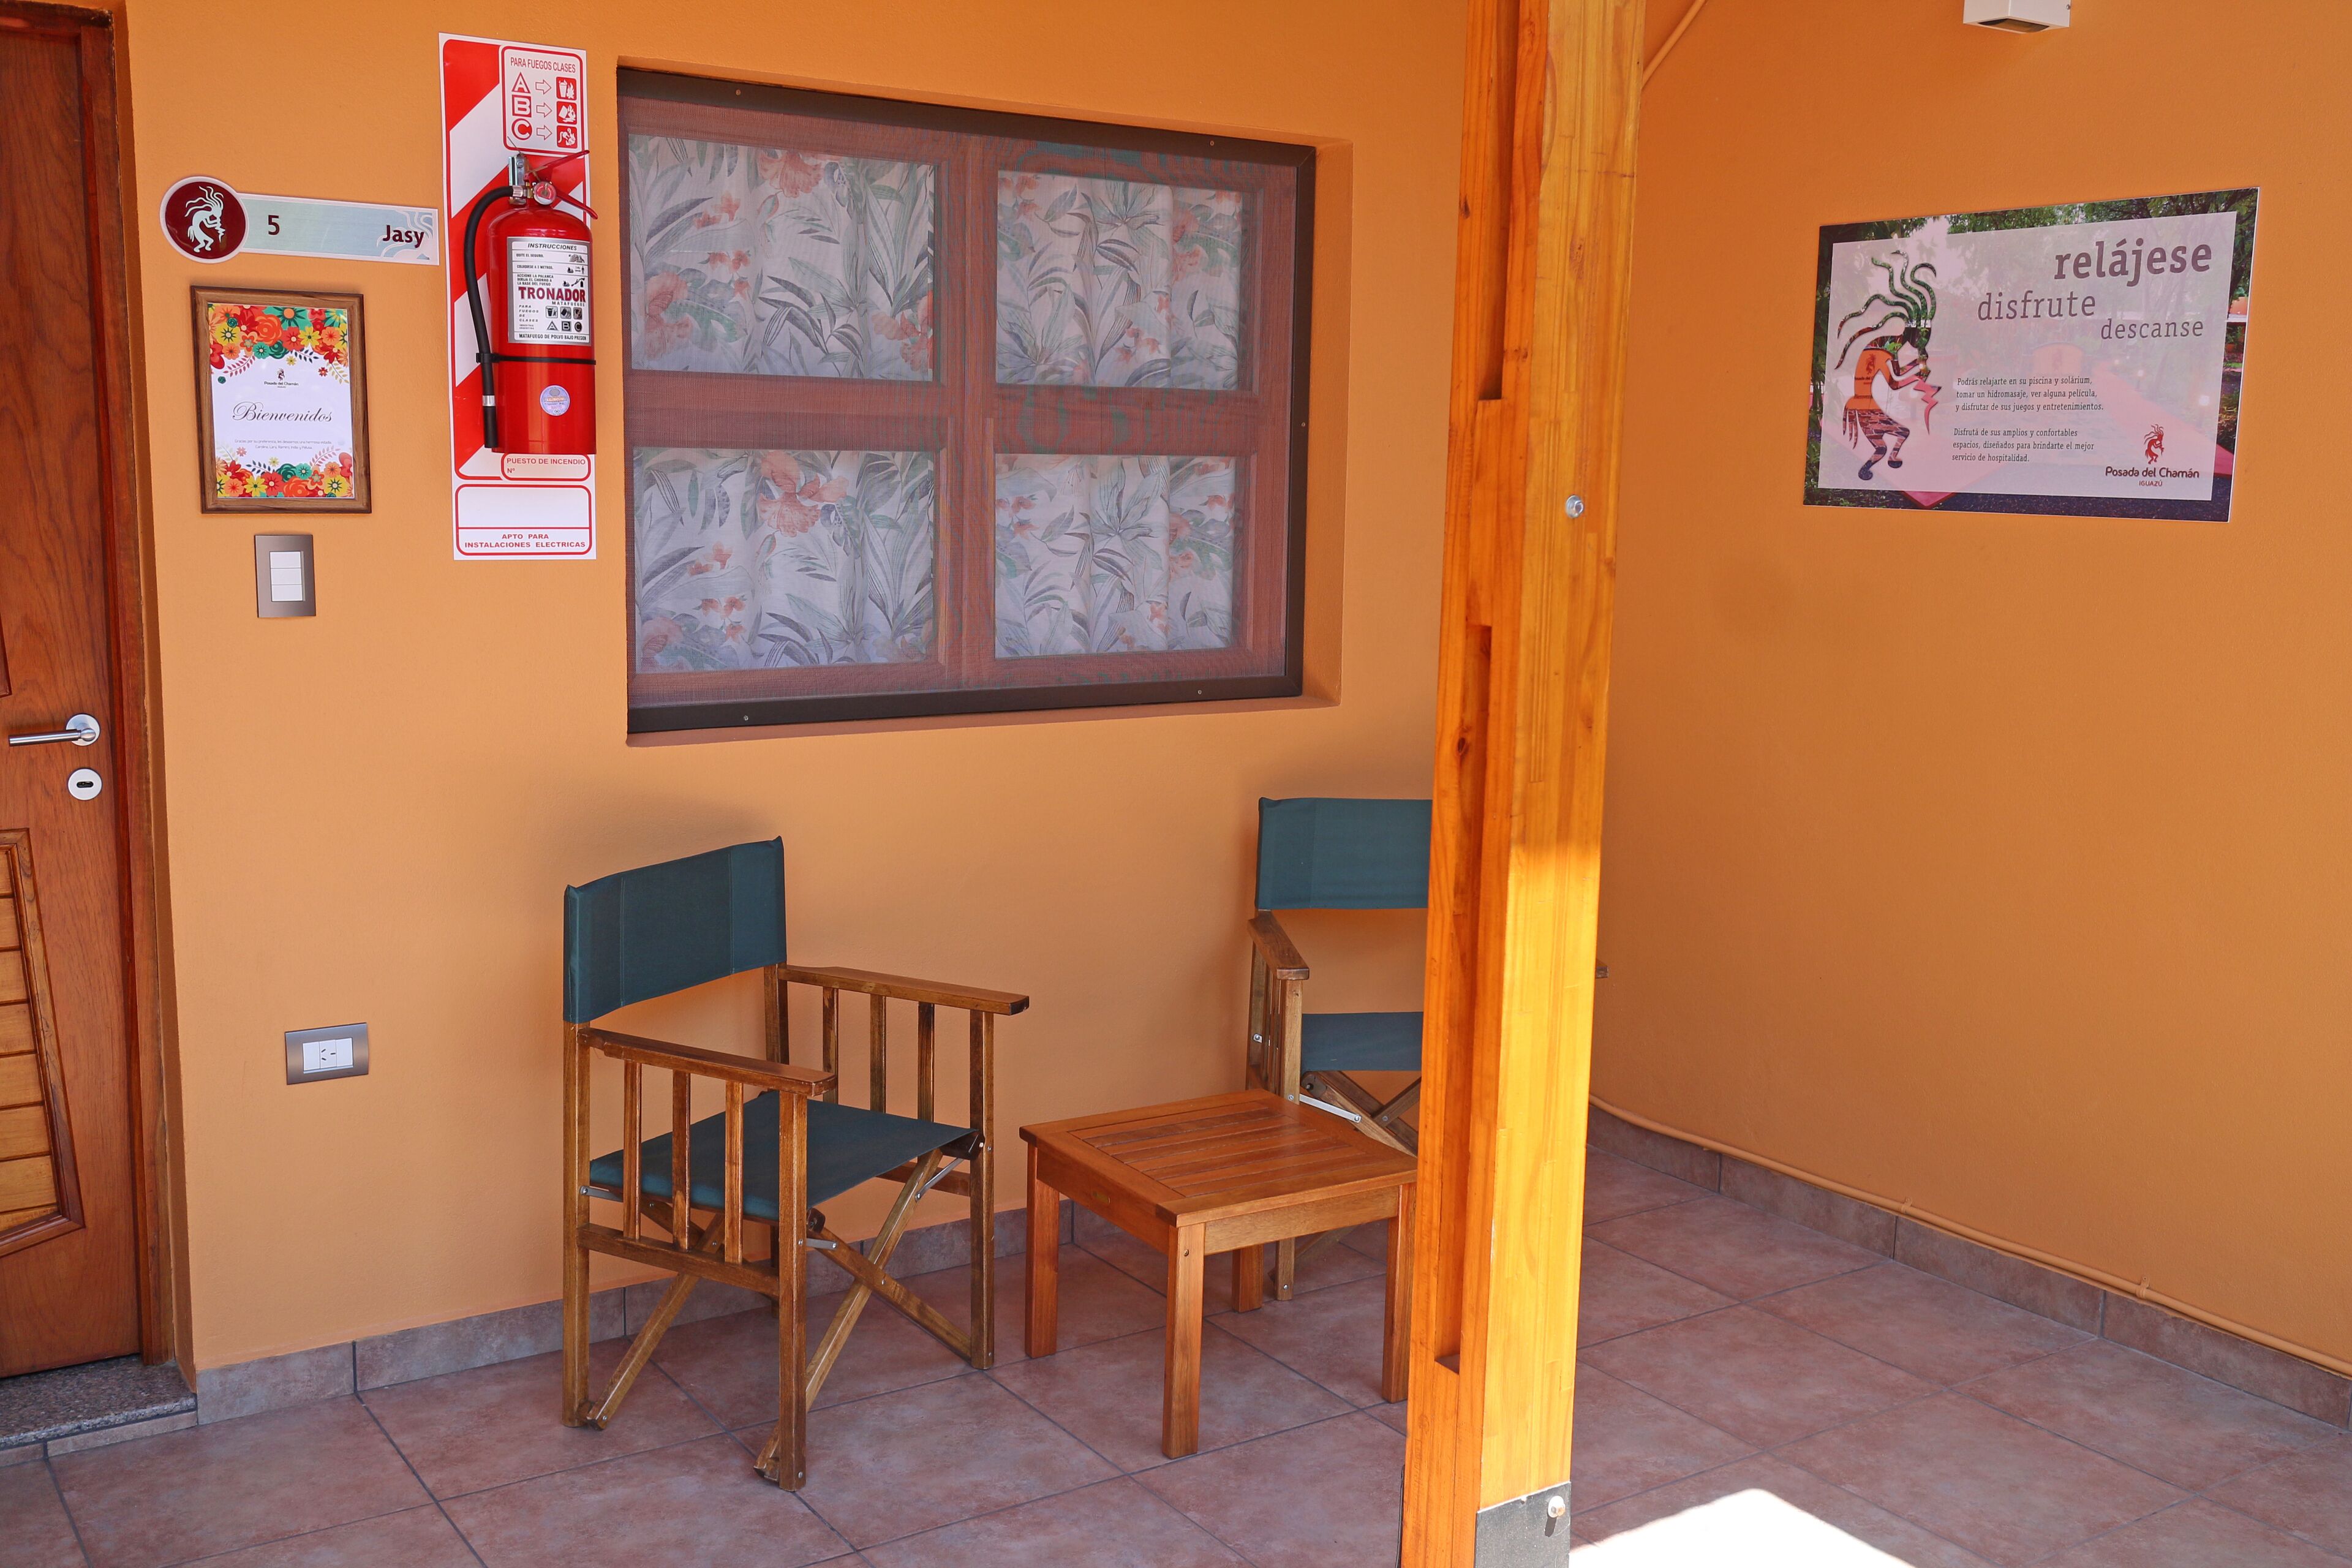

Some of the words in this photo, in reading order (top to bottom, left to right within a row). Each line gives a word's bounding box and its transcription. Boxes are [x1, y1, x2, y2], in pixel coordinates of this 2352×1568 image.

[510, 57, 526, 67] PARA
[527, 59, 552, 70] FUEGOS
[552, 62, 576, 73] CLASES
[513, 73, 530, 93] A
[514, 96, 530, 116] B
[513, 119, 530, 139] C
[267, 215, 281, 235] 5
[382, 224, 425, 248] Jasy
[2054, 238, 2212, 287] relájese
[518, 287, 586, 303] TRONADOR
[1977, 290, 2096, 320] disfrute
[564, 322, 570, 331] B
[575, 322, 582, 331] C
[2100, 318, 2204, 339] descanse
[1980, 377, 2007, 388] relajarte
[2029, 376, 2052, 386] piscina
[2061, 376, 2092, 385] solárium,
[1988, 390, 2028, 399] hidromasaje,
[2043, 389, 2065, 399] alguna
[2068, 388, 2097, 399] película,
[232, 401, 333, 422] Bienvenidos
[2013, 402, 2034, 412] juegos
[2037, 404, 2041, 412] y
[2043, 402, 2103, 410] entretenimientos.
[2003, 429, 2027, 438] amplios
[1953, 442, 1980, 451] espacios,
[2075, 443, 2094, 451] mejor
[1988, 454, 2029, 463] hospitalidad.
[2105, 466, 2139, 477] Posada
[2141, 467, 2156, 477] del
[2158, 467, 2199, 478] Chamán
